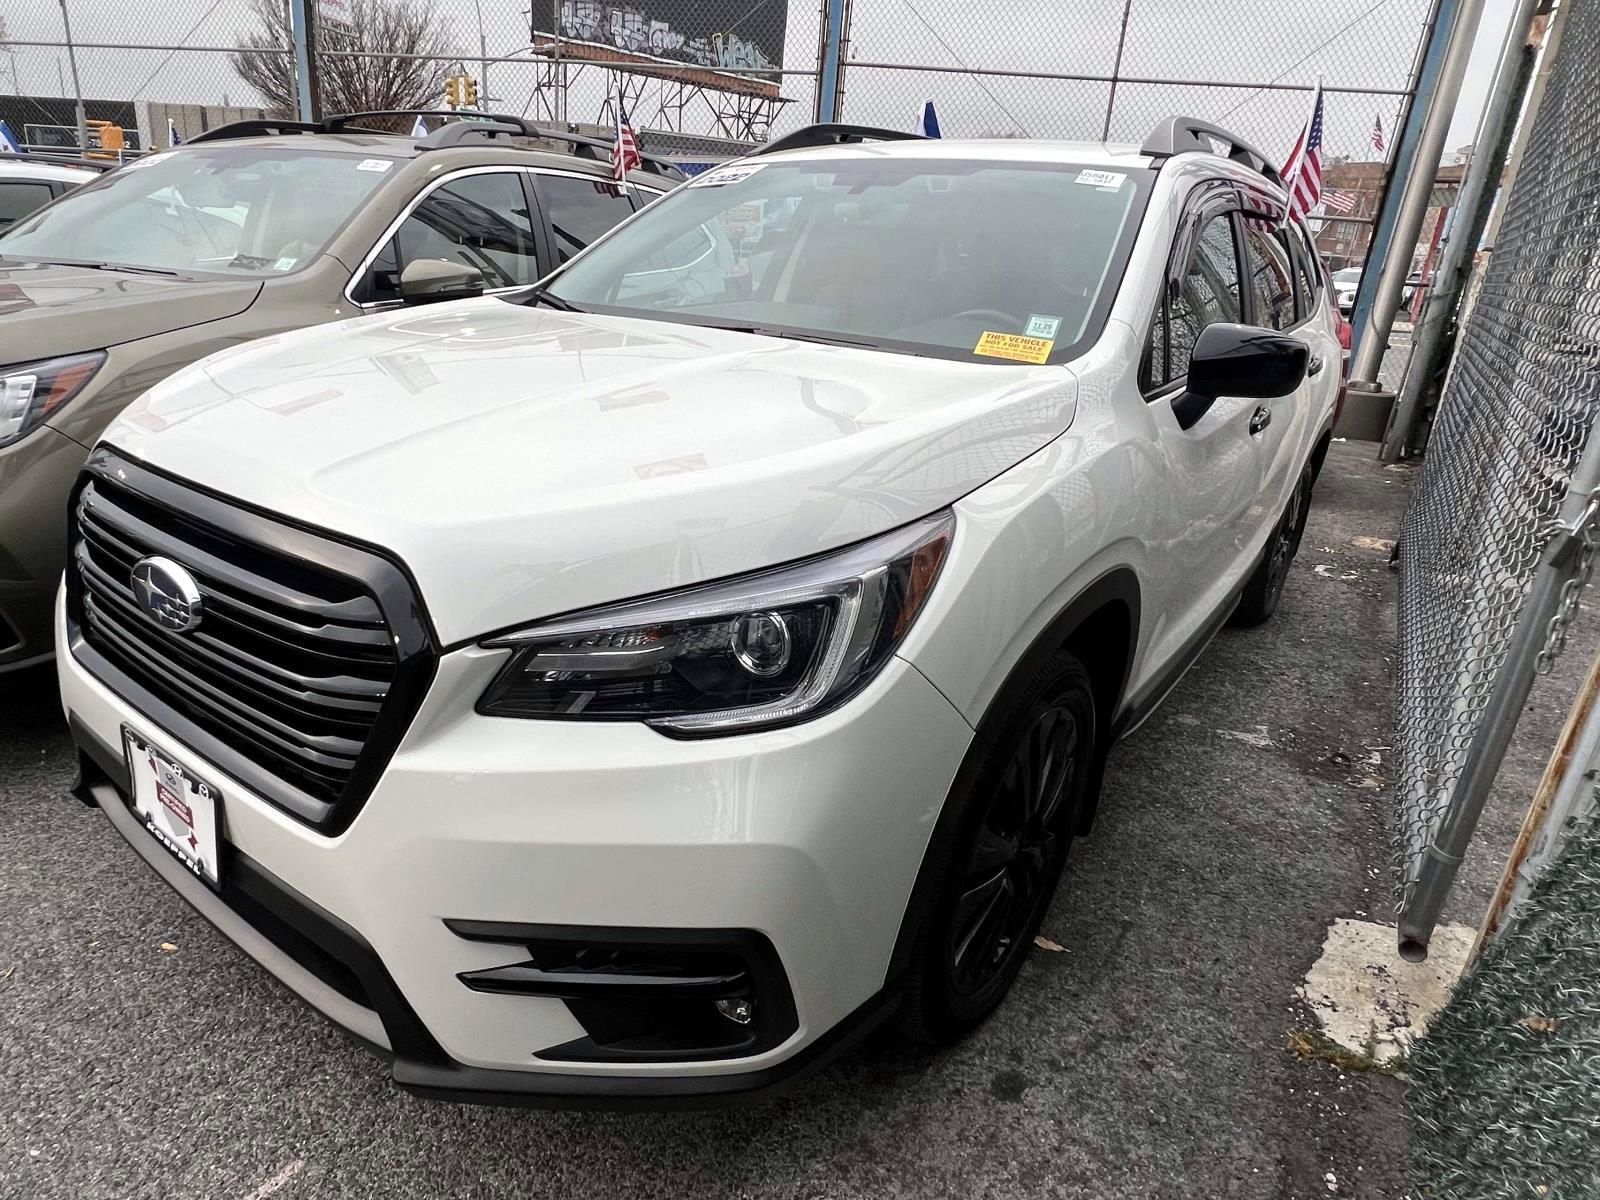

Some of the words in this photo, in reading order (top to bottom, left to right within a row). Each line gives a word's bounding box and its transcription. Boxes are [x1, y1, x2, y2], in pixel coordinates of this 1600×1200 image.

[985, 333, 1006, 342] THIS
[1009, 336, 1049, 348] VEHICLE
[146, 821, 201, 876] KOEPPEL
